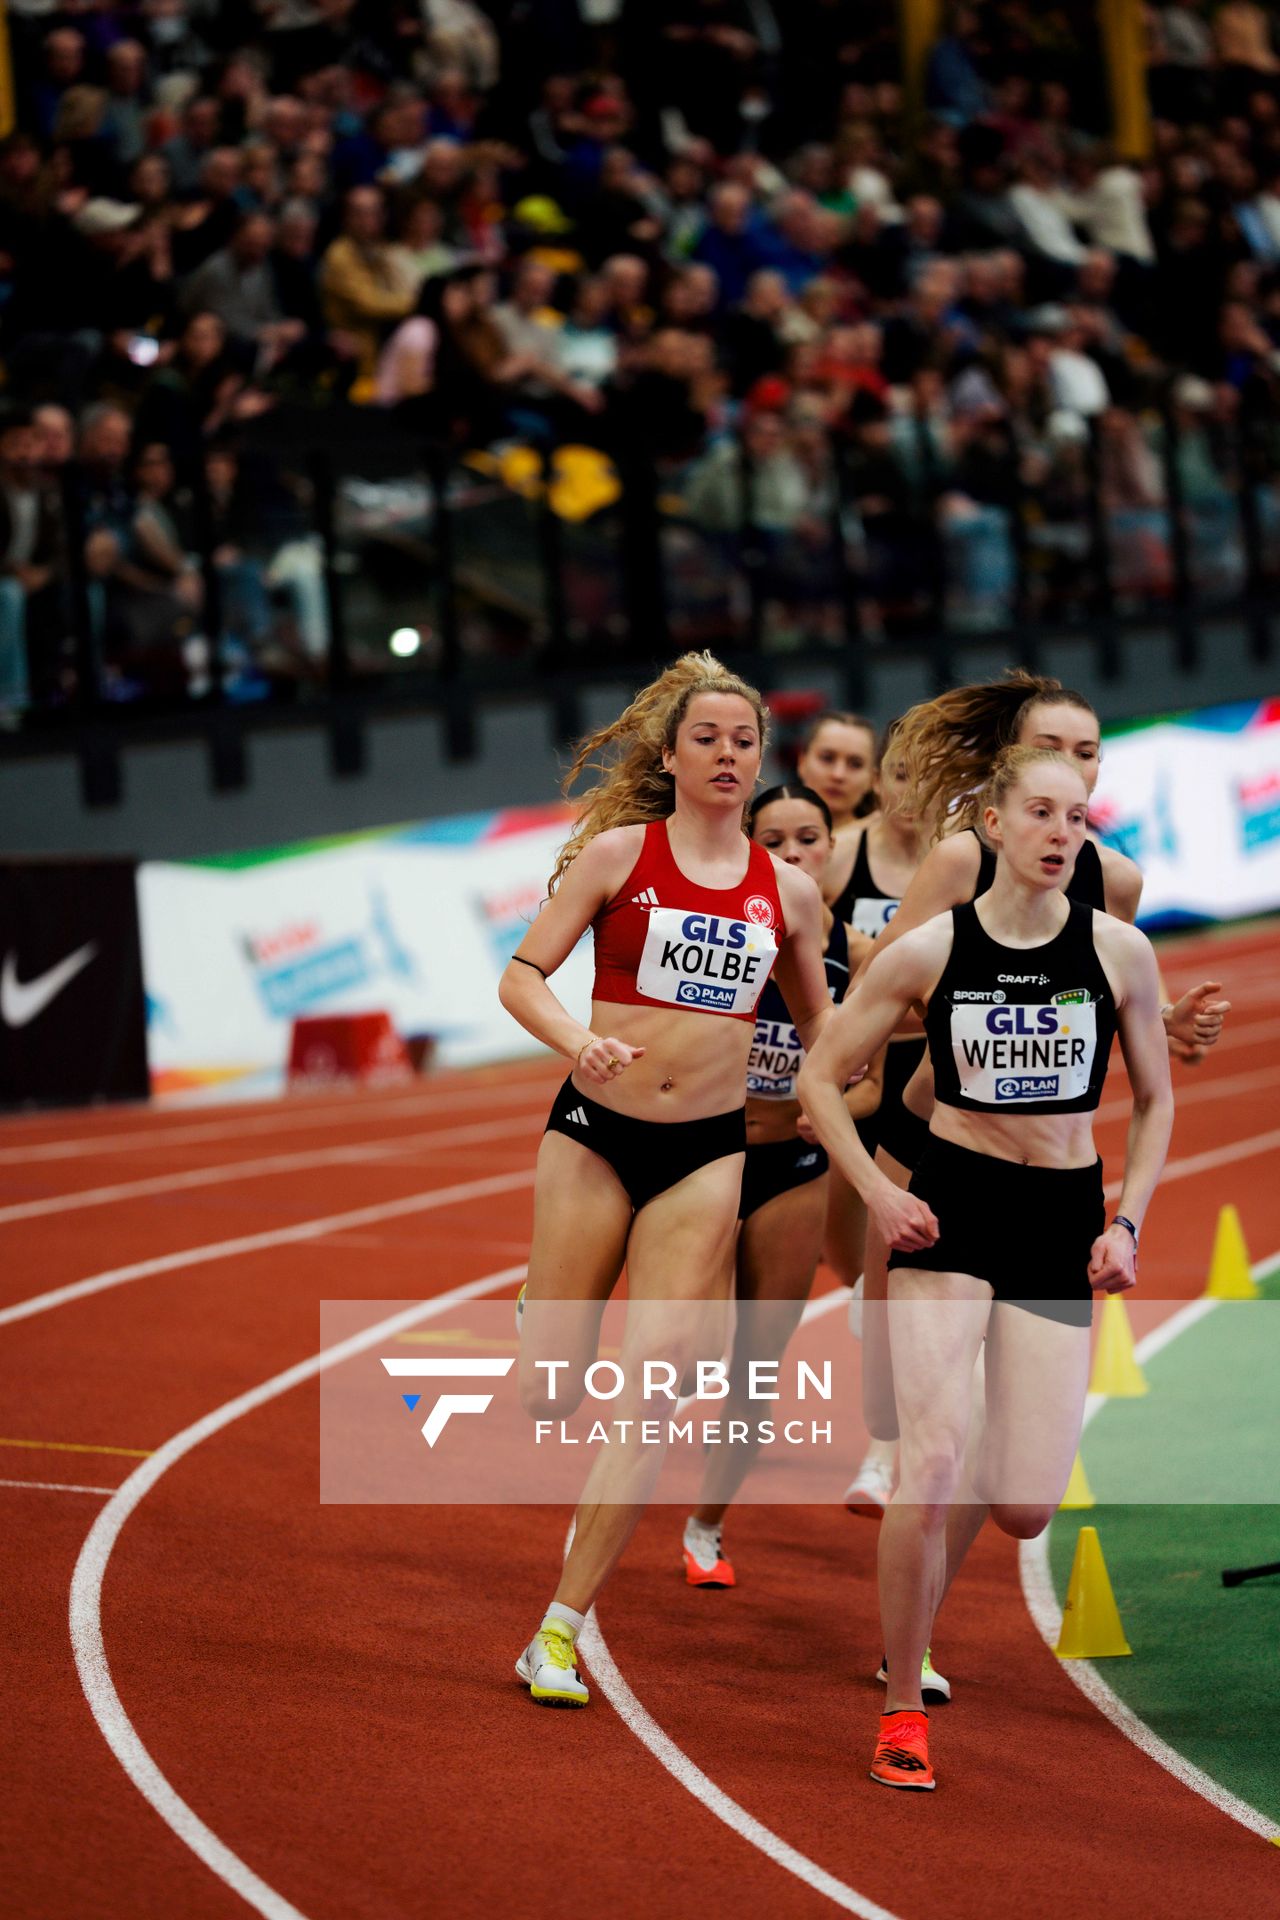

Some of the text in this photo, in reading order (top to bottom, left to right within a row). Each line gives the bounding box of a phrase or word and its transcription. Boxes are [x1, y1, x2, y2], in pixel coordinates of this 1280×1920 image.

[660, 940, 762, 984] KOLBE
[997, 974, 1038, 984] CRAFT
[701, 988, 734, 1002] PLAN
[752, 1022, 803, 1050] GLS
[962, 1038, 1086, 1069] WEHNER
[1021, 1079, 1057, 1091] PLAN
